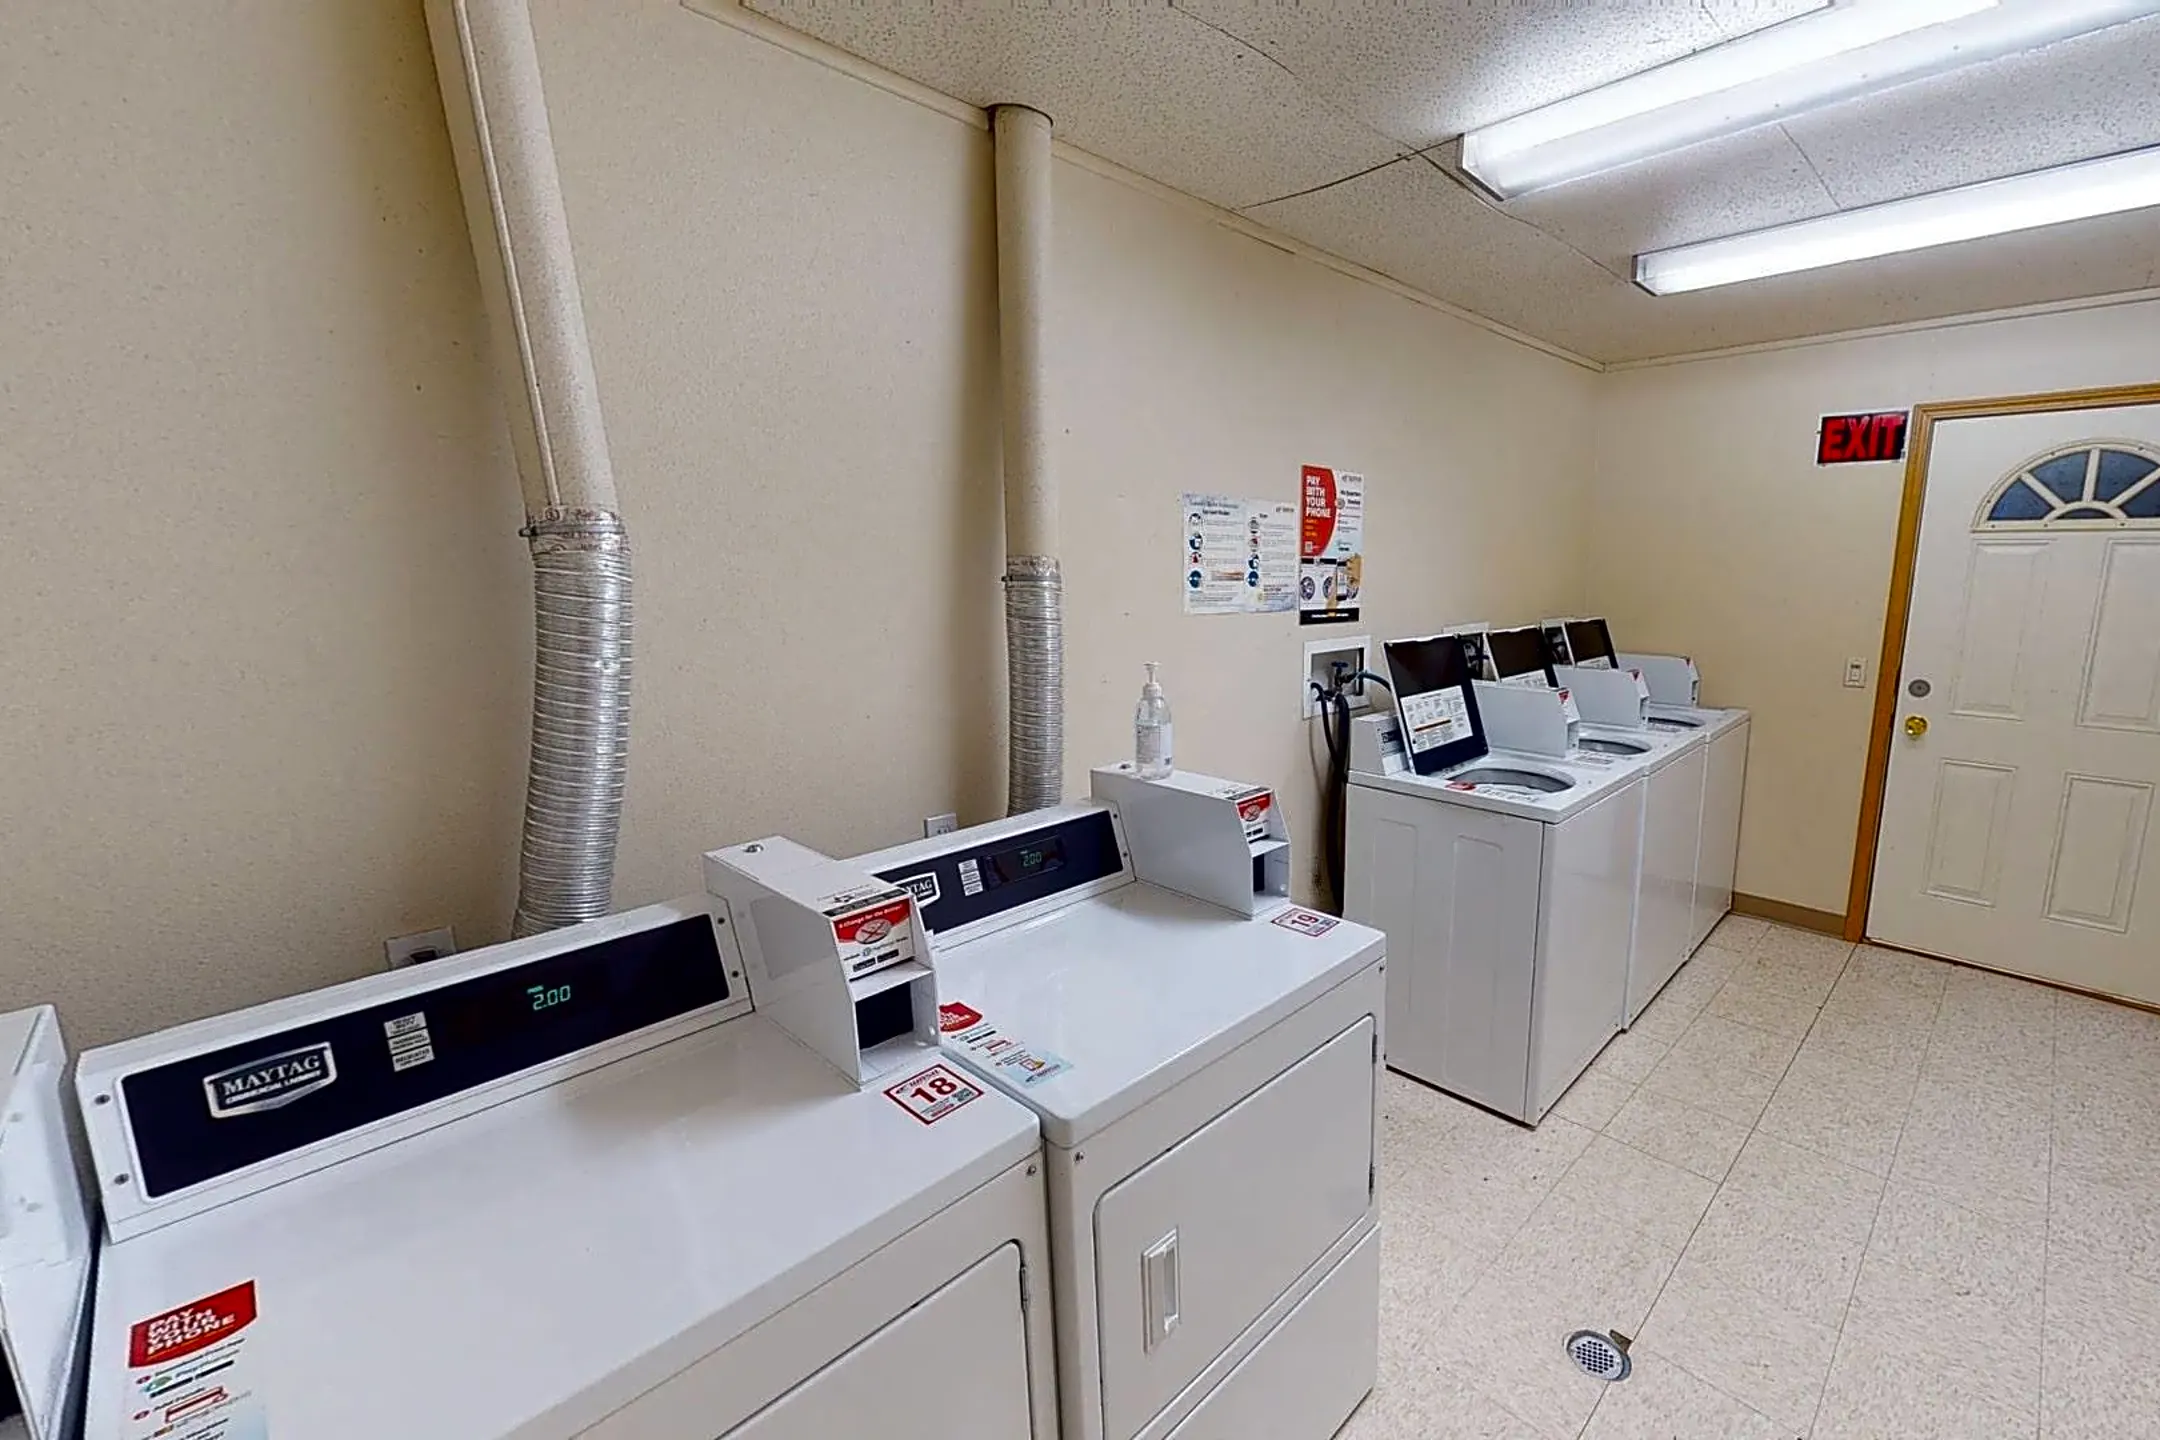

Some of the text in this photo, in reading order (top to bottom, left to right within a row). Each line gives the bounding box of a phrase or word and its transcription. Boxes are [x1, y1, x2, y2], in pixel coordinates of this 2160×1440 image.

[1822, 414, 1905, 460] EXIT
[1306, 475, 1321, 487] PAY
[1306, 486, 1325, 497] WITH
[1306, 497, 1326, 508] YOUR
[1306, 507, 1331, 518] PHONE
[906, 879, 933, 895] YTAG
[1291, 914, 1320, 927] 19
[222, 1055, 321, 1095] MAYTAG
[910, 1077, 957, 1103] 18
[147, 1314, 217, 1346] YOUR
[148, 1308, 214, 1338] WITH
[149, 1307, 194, 1331] PAY
[147, 1313, 236, 1356] PHONE
